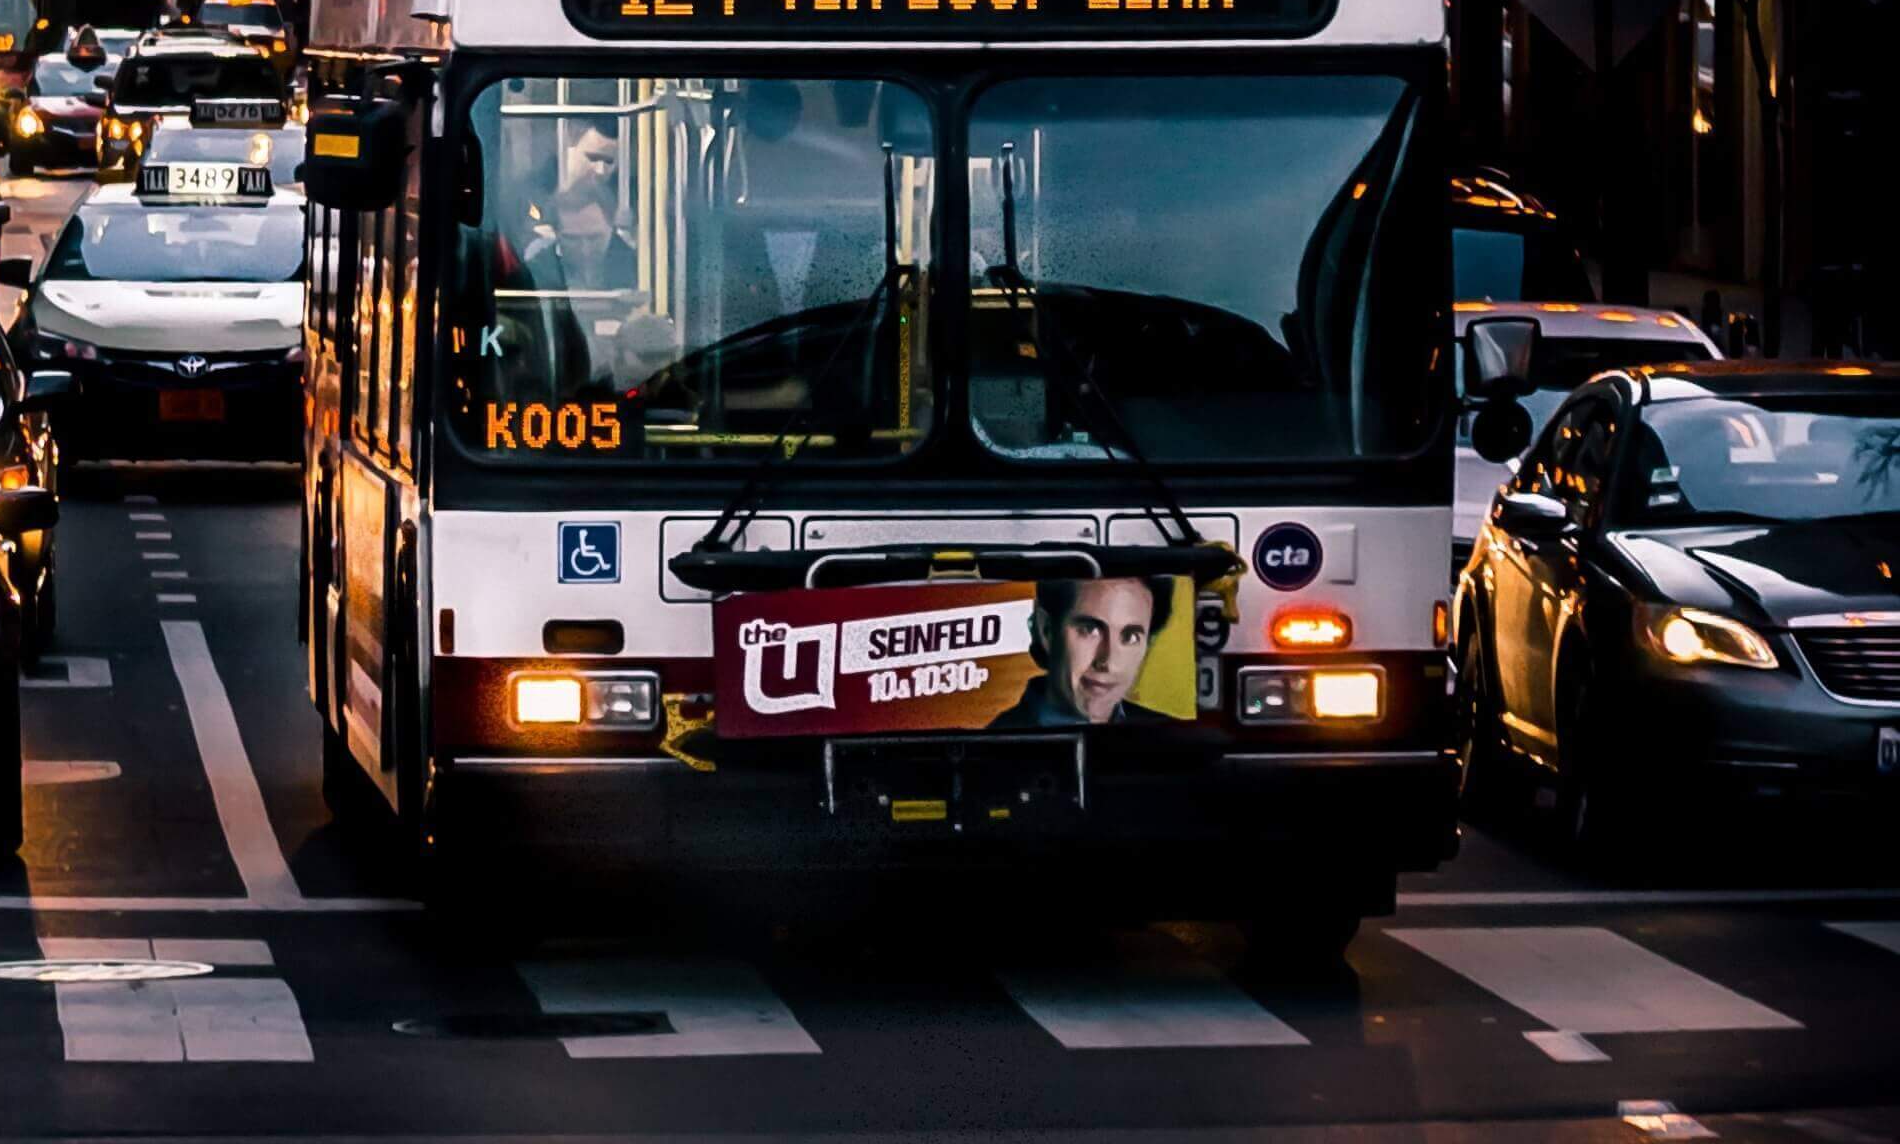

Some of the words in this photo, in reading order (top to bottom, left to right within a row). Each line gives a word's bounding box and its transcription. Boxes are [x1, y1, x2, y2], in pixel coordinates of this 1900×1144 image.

[175, 167, 235, 189] 3489
[487, 403, 621, 449] K005
[1265, 544, 1311, 568] cta
[741, 621, 789, 647] the
[868, 615, 1000, 659] SEINFELD
